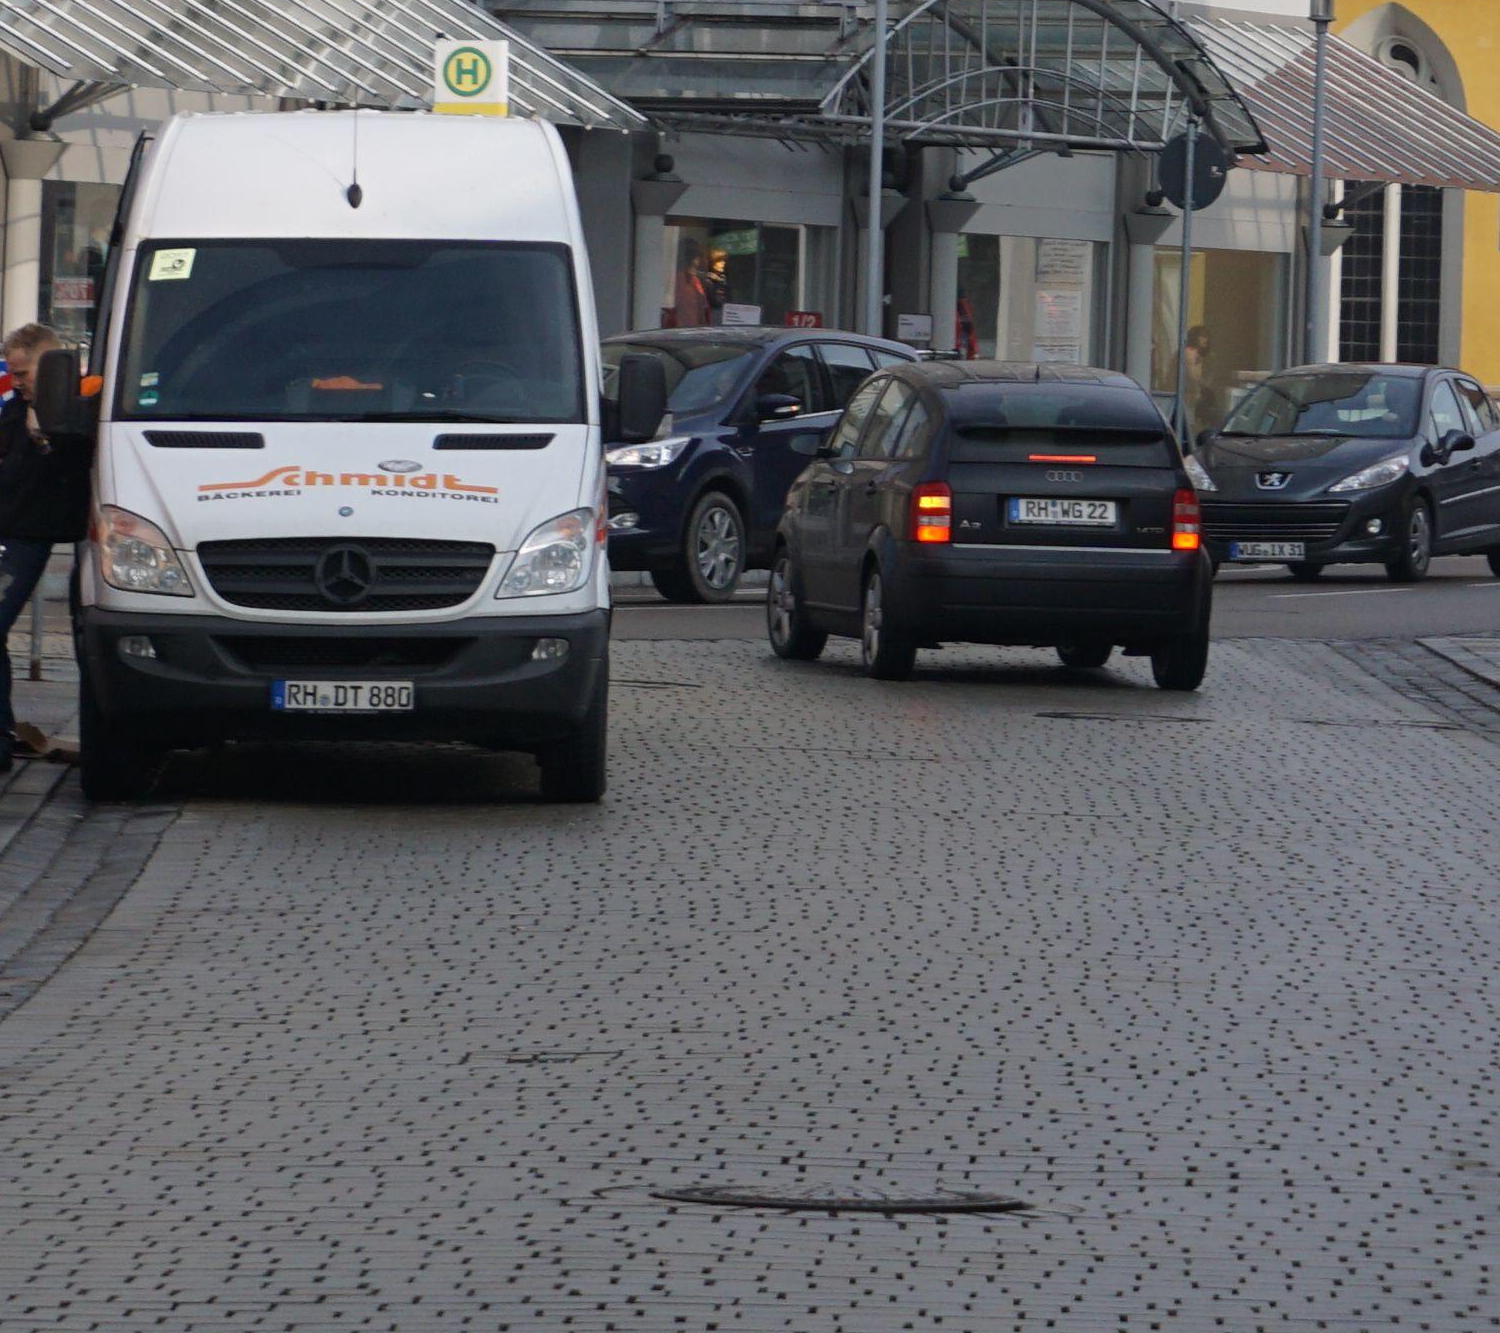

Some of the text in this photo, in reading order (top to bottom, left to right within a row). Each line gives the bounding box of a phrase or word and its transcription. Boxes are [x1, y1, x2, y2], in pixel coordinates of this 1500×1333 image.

[456, 58, 479, 85] H
[198, 465, 499, 495] Schmidt
[196, 489, 302, 502] BÄCKEREI
[371, 489, 499, 504] KONDITOREI
[1025, 501, 1108, 520] RH WG 22
[287, 684, 411, 708] RH DT 880
